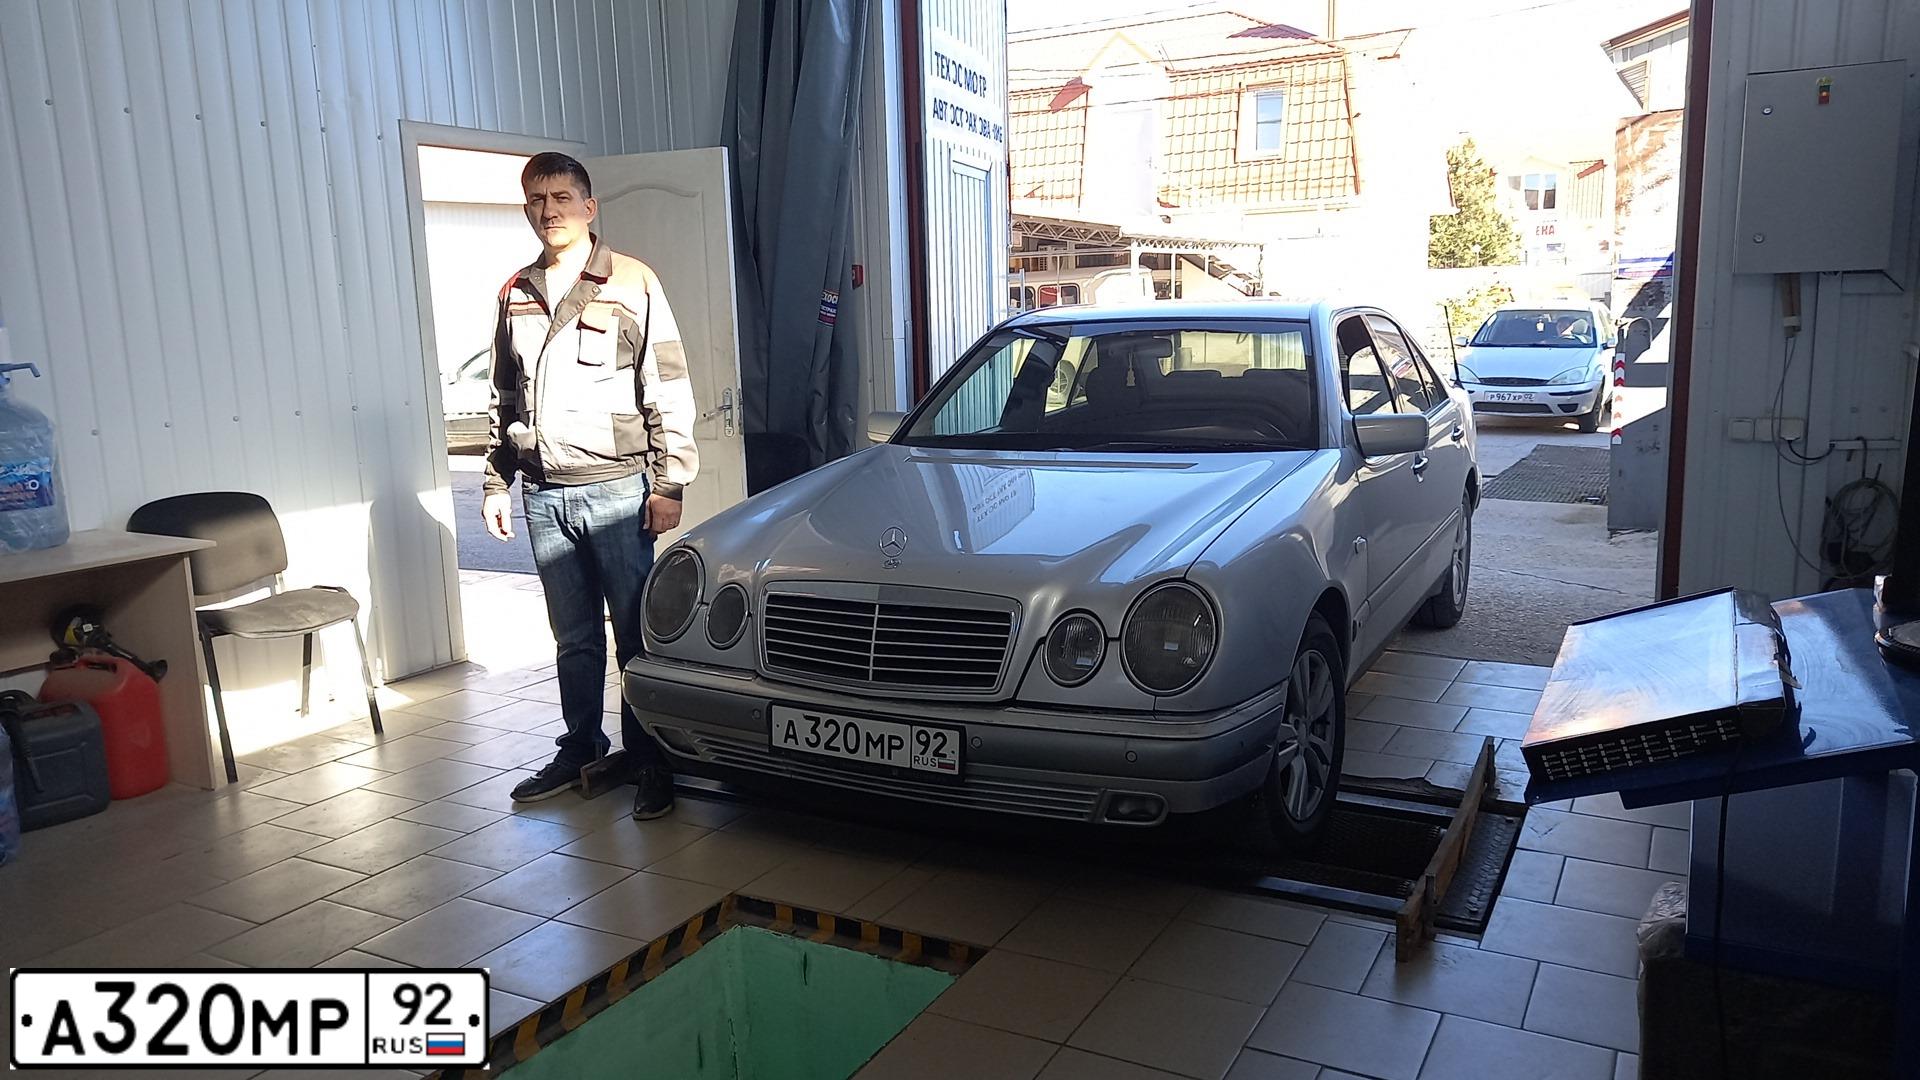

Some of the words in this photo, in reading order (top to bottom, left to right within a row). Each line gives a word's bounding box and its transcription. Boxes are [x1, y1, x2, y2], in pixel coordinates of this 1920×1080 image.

[783, 713, 905, 761] А320МР
[915, 729, 948, 759] 92
[913, 756, 937, 768] RUS
